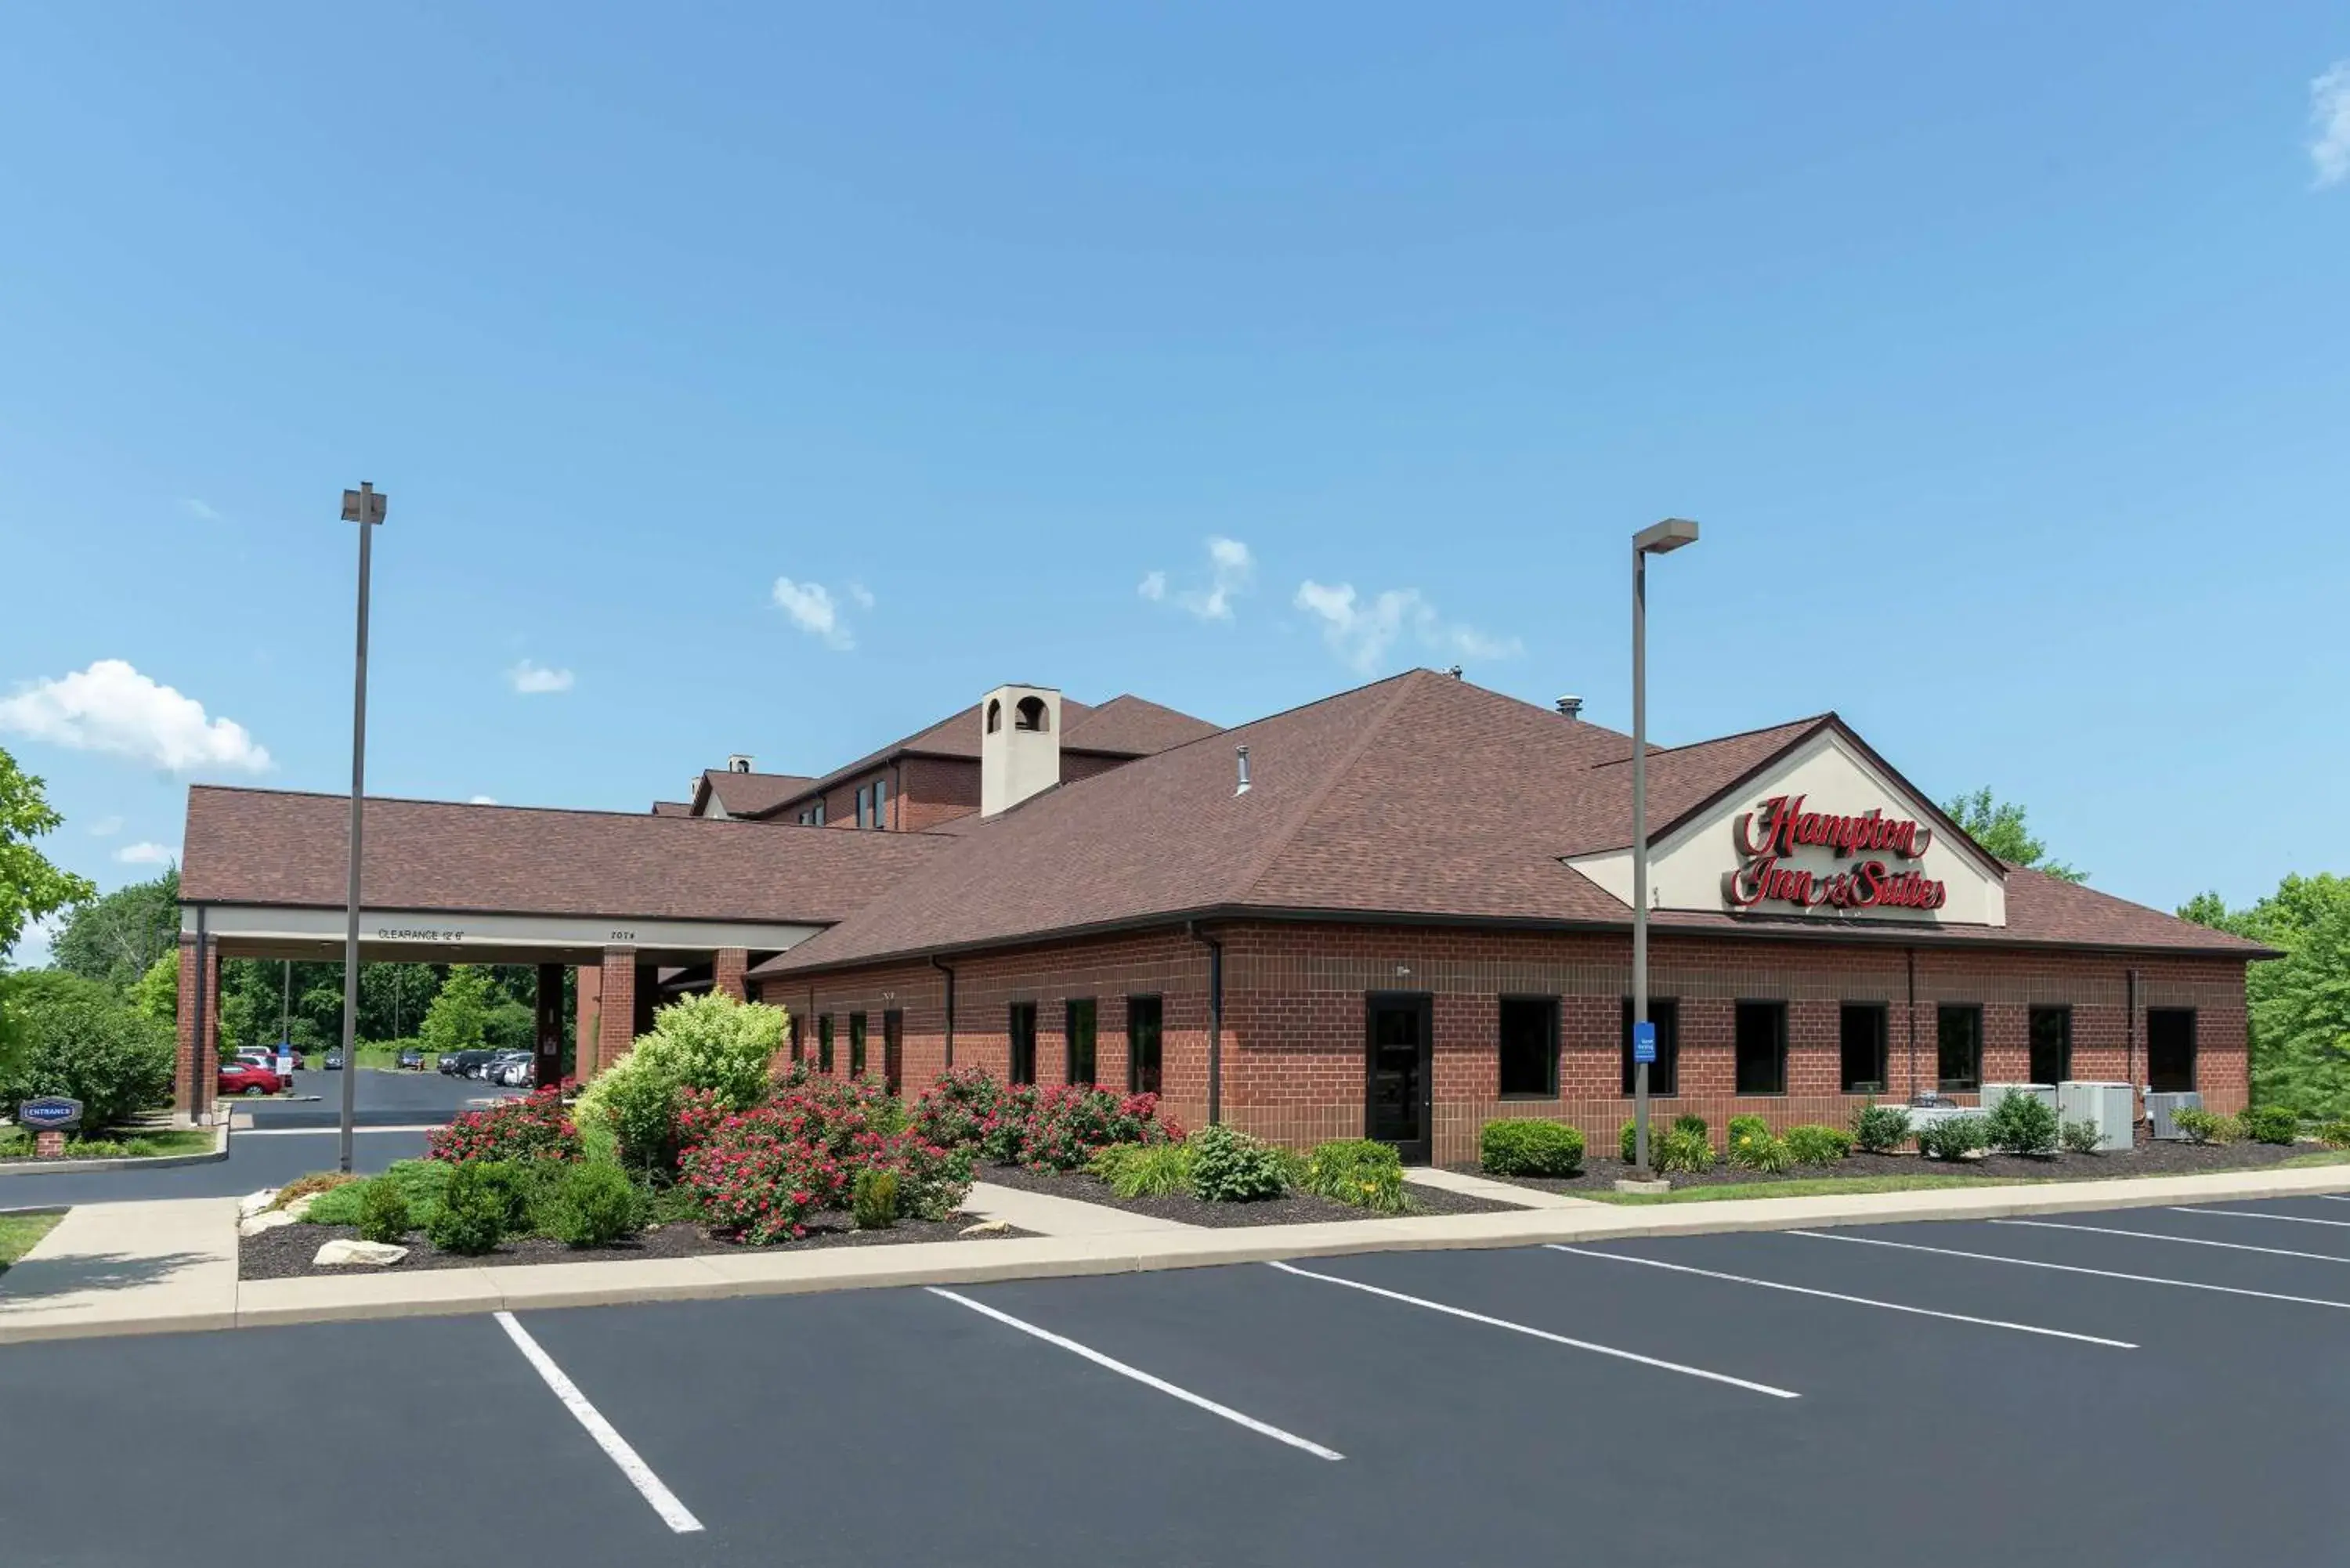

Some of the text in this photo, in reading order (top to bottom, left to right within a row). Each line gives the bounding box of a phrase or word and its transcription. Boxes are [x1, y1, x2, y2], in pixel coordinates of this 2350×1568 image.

[1744, 793, 1931, 859] Hampton
[1731, 856, 1831, 907] Inn
[1850, 861, 1947, 909] Suites
[378, 928, 438, 940] CLEARANCE
